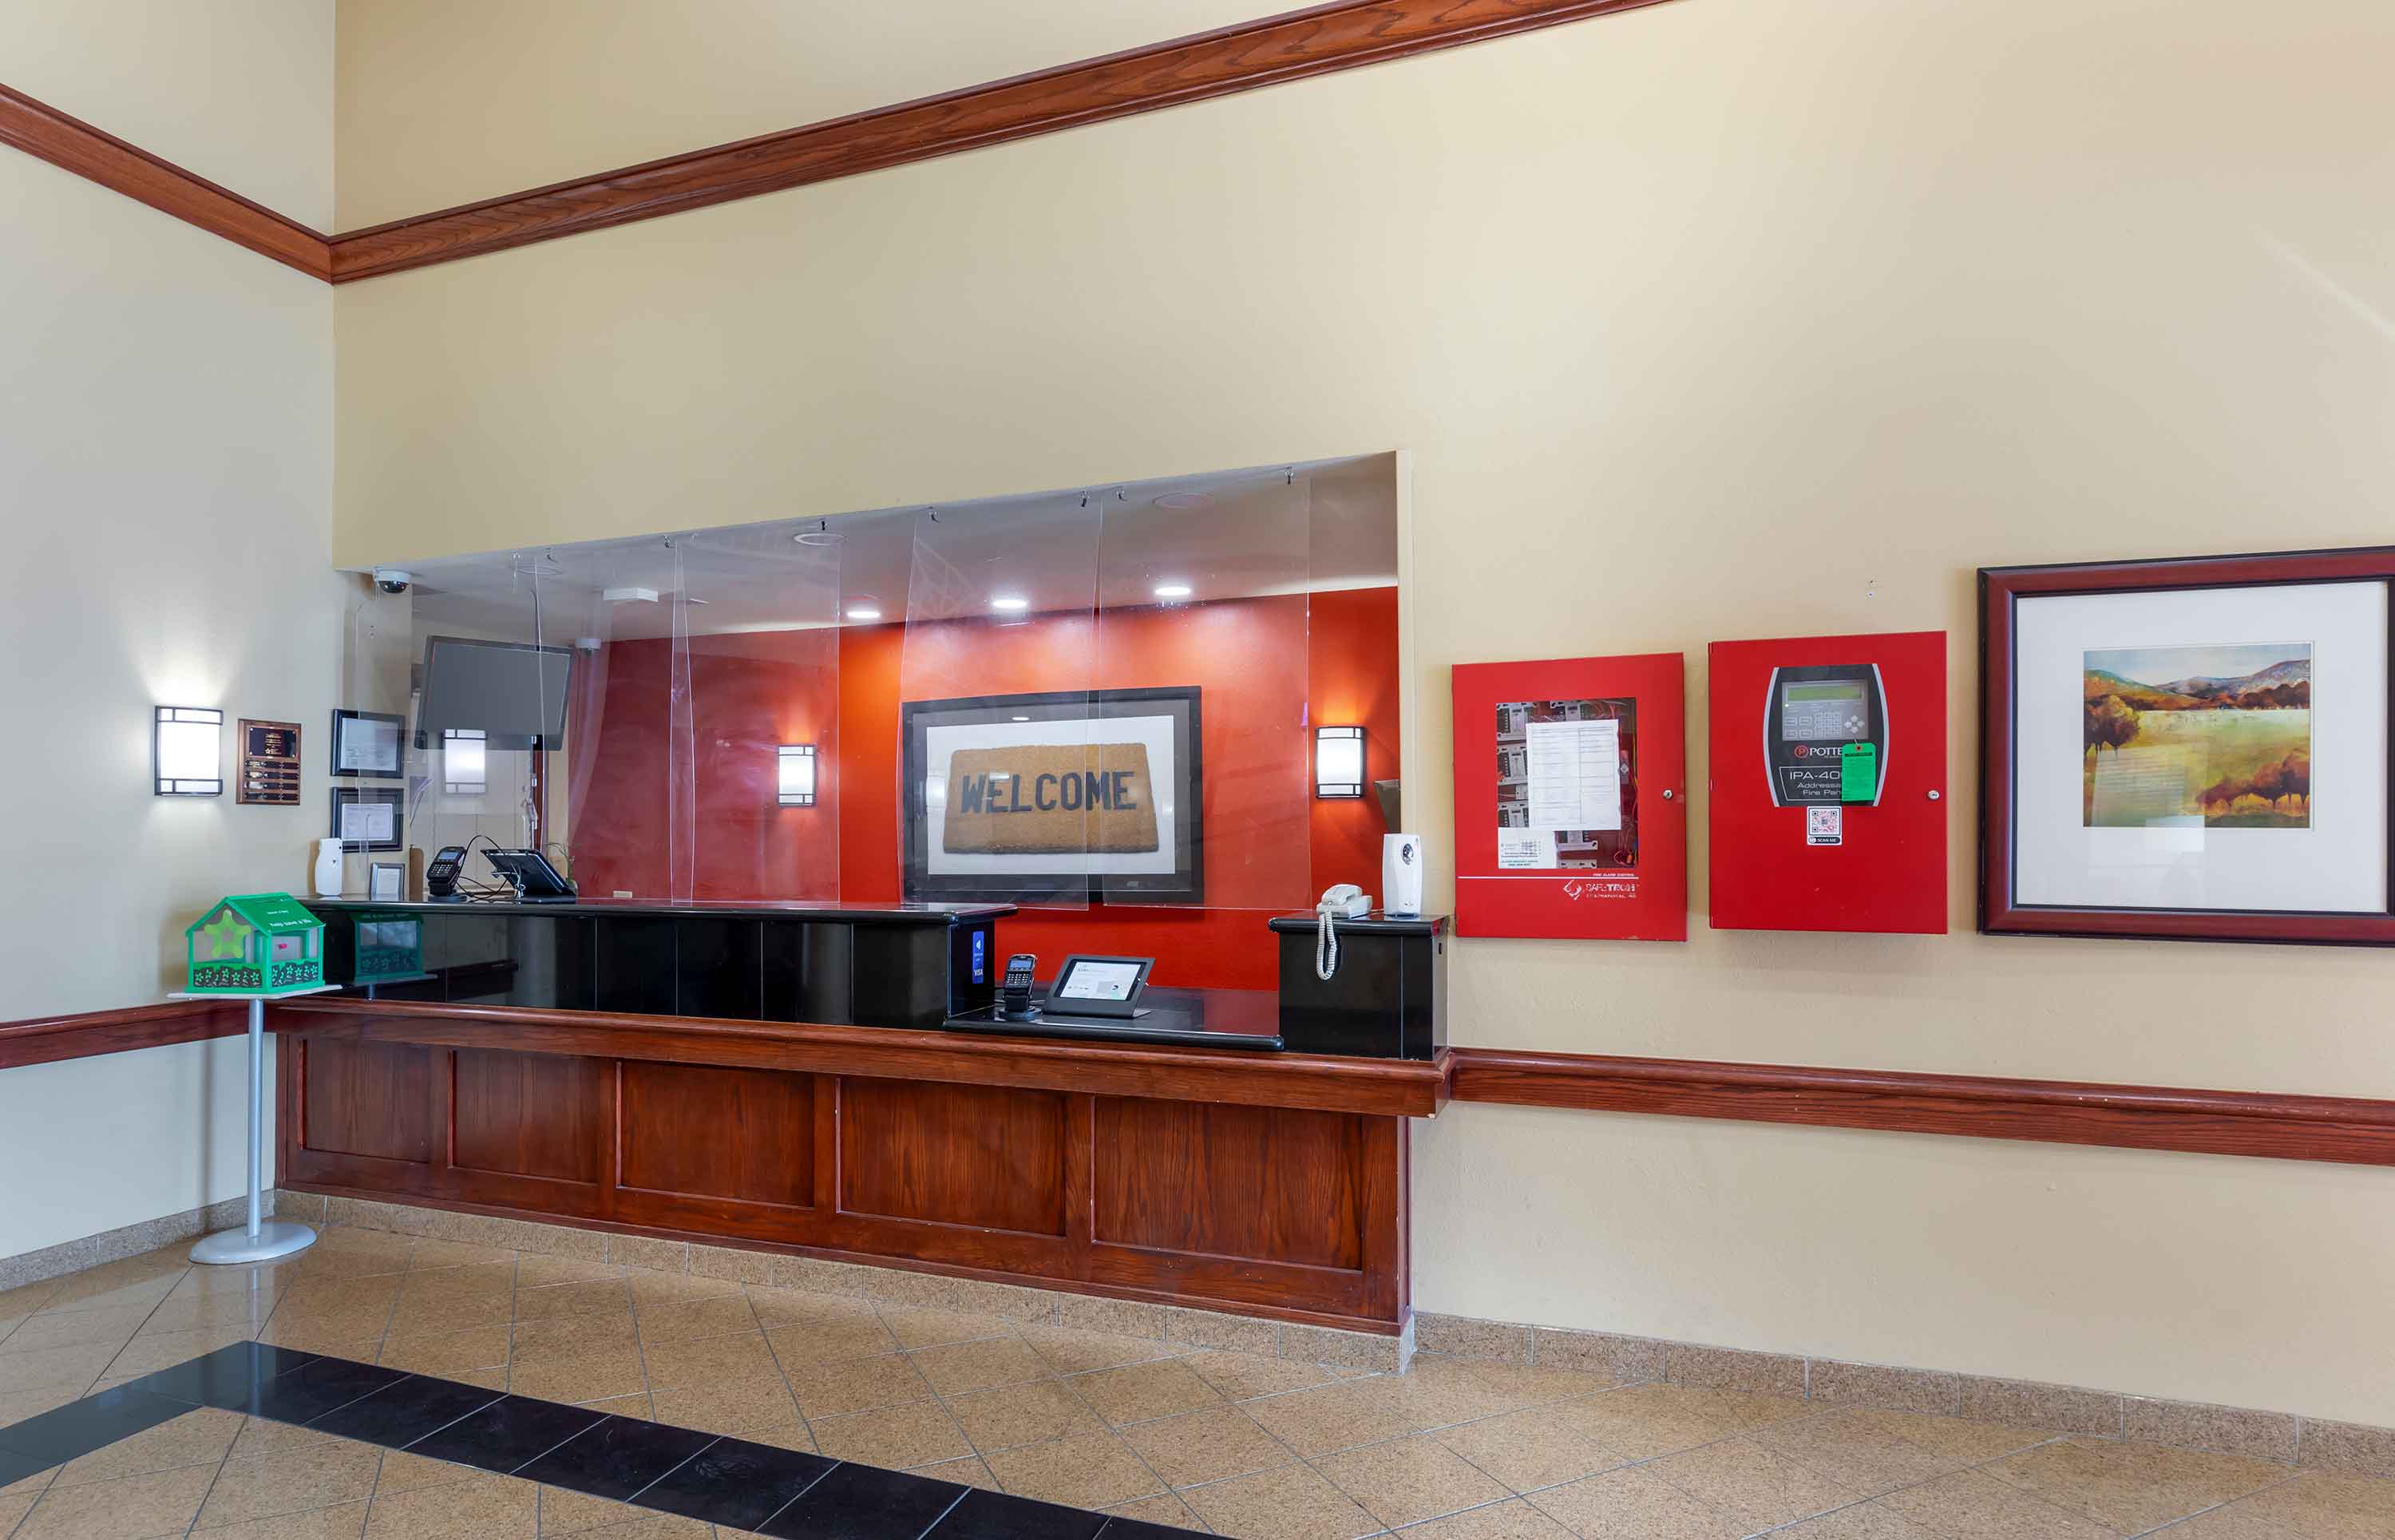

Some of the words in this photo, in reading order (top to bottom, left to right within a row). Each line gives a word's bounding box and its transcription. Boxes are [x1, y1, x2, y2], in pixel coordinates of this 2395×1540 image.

[1809, 747, 1843, 756] POTTE
[1790, 770, 1842, 780] IPA-40
[960, 771, 1137, 813] WELCOME
